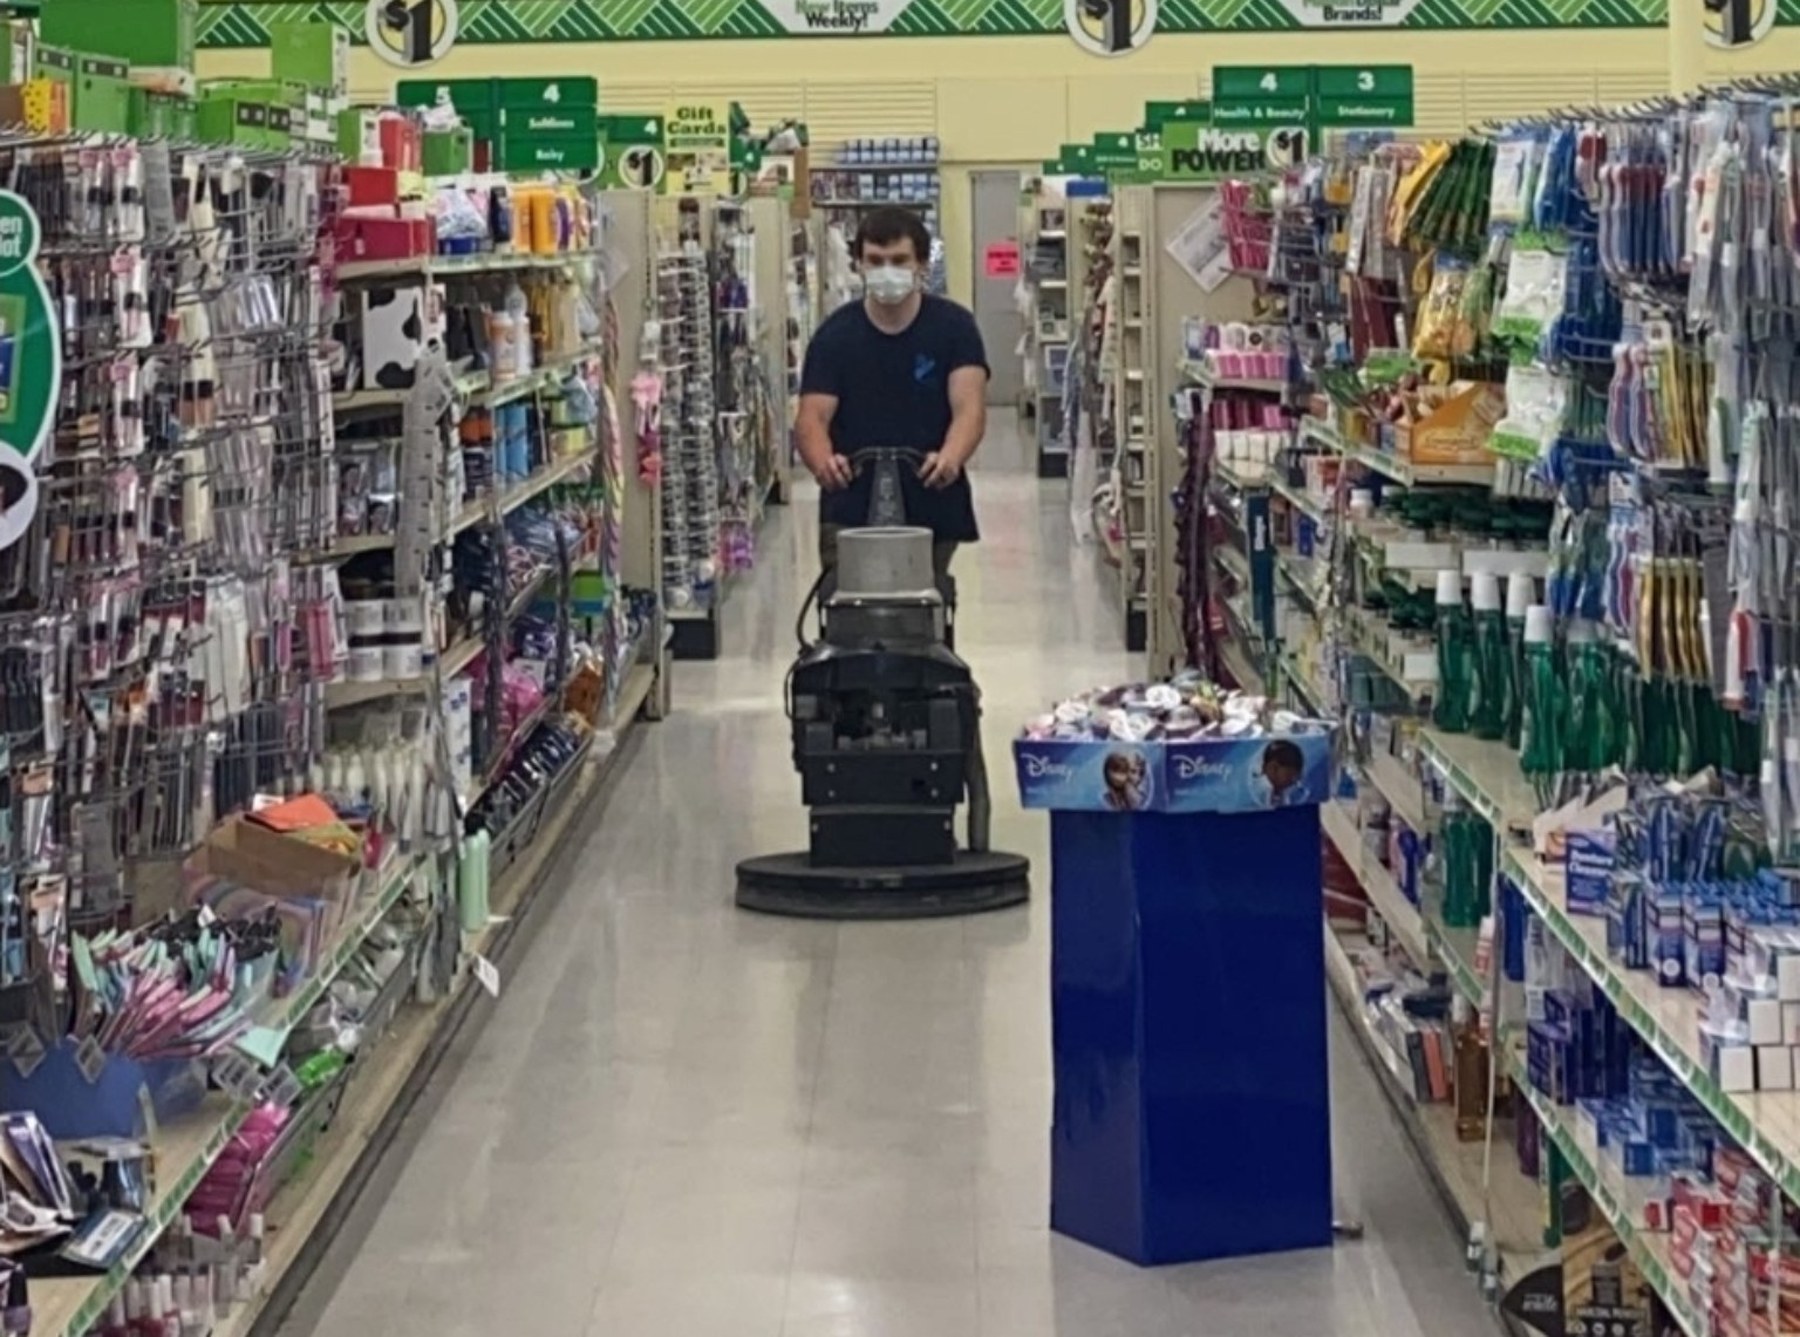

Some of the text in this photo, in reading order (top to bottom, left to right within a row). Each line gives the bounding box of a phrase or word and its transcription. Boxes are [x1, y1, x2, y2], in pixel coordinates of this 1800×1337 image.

[805, 10, 868, 33] Weekly!
[1323, 4, 1383, 21] Brands!
[1260, 73, 1277, 92] 4
[1358, 72, 1375, 91] 3
[543, 84, 560, 103] 4
[676, 106, 714, 121] Gift
[1214, 107, 1251, 119] Health
[1266, 107, 1305, 121] Beauty
[645, 119, 658, 135] 4
[667, 121, 727, 135] Cards
[1198, 128, 1260, 153] More
[1171, 149, 1266, 172] POWER
[1021, 753, 1073, 783] Disney
[1172, 754, 1232, 781] Disney
